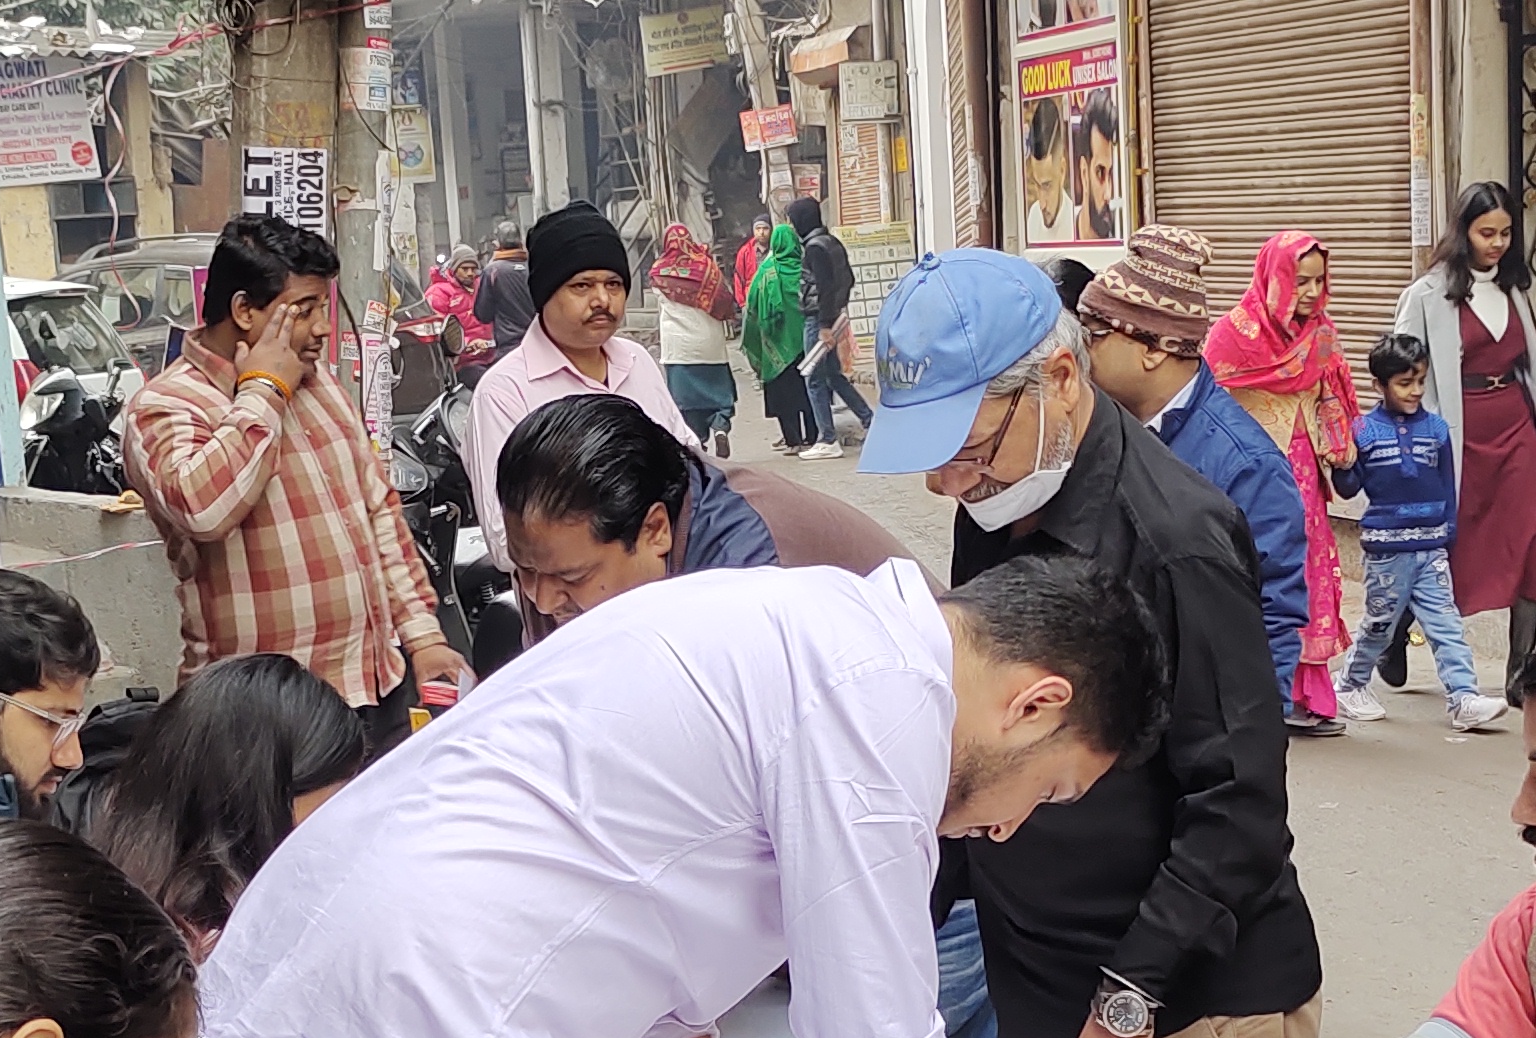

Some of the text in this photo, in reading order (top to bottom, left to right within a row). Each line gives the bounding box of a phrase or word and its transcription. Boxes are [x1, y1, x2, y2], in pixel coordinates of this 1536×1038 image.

[45, 78, 83, 96] CLINIC
[1021, 64, 1046, 95] GOOD
[1047, 59, 1072, 91] LUCK
[1072, 62, 1096, 87] UNISEX
[273, 150, 282, 167] SET
[283, 150, 294, 185] HALL
[243, 148, 273, 220] LET
[296, 150, 324, 229] 106204
